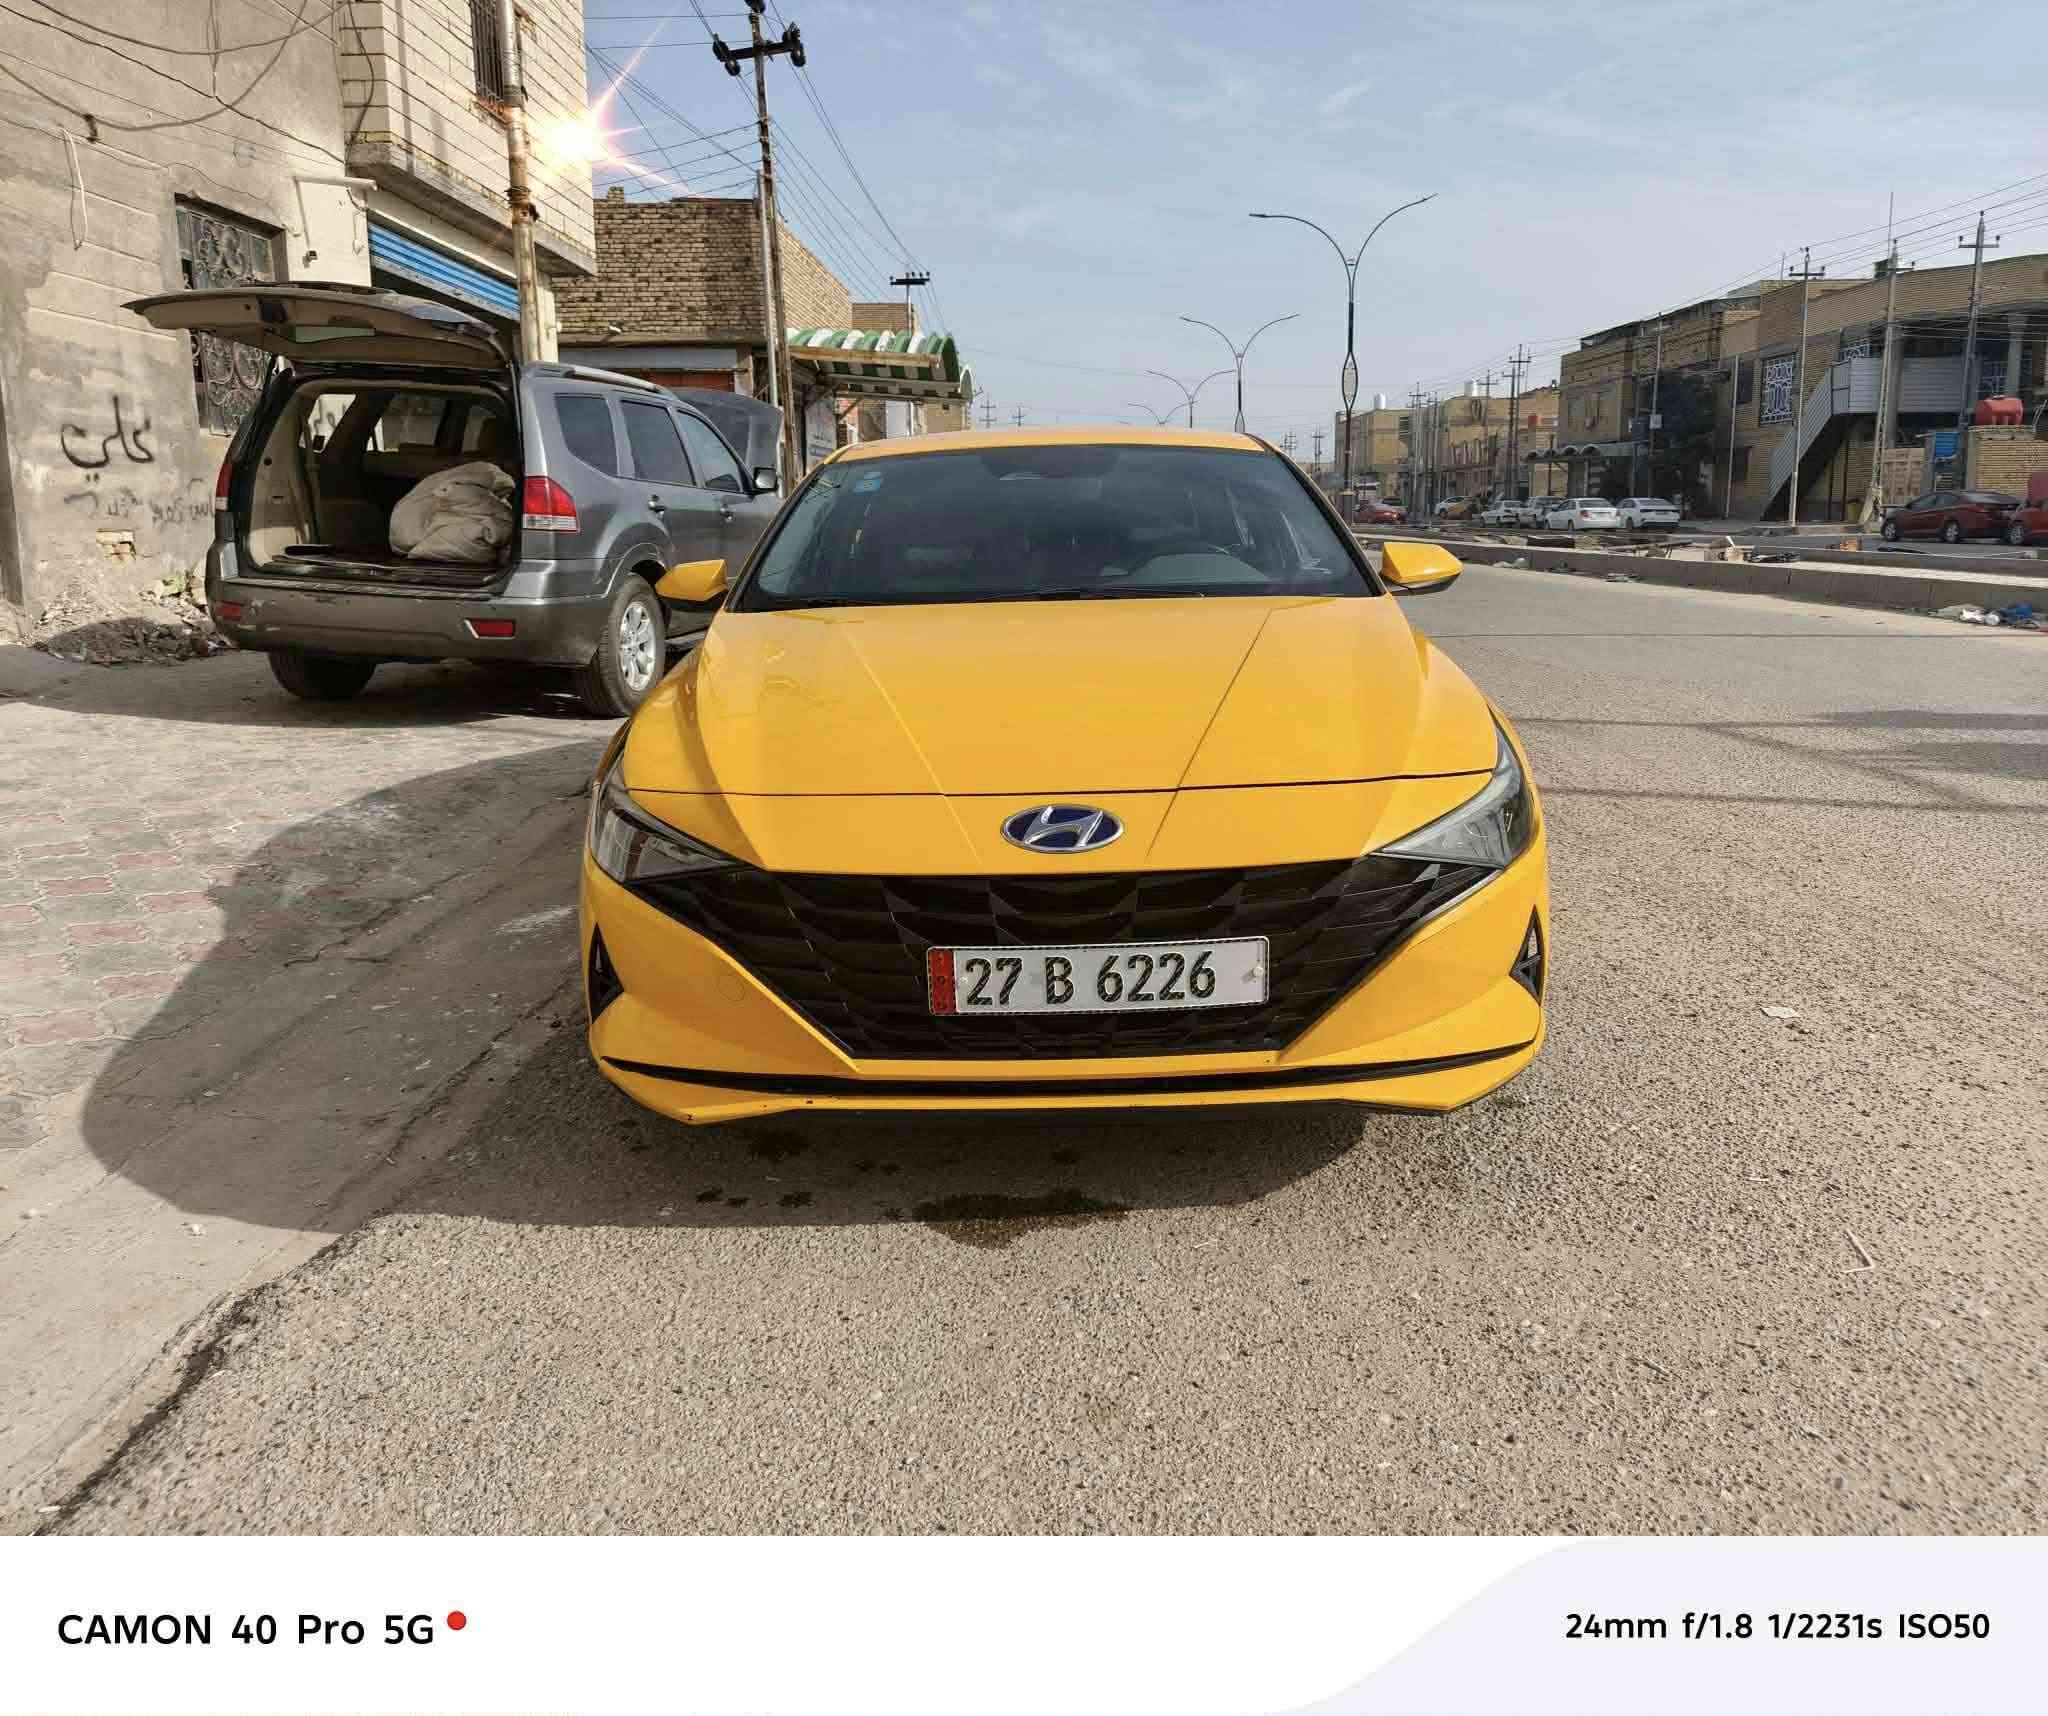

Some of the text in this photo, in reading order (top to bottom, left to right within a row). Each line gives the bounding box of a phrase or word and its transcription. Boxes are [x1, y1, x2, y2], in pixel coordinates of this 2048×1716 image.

[965, 957, 1022, 1006] 27
[1045, 956, 1074, 1005] B
[1097, 950, 1216, 1003] 6226
